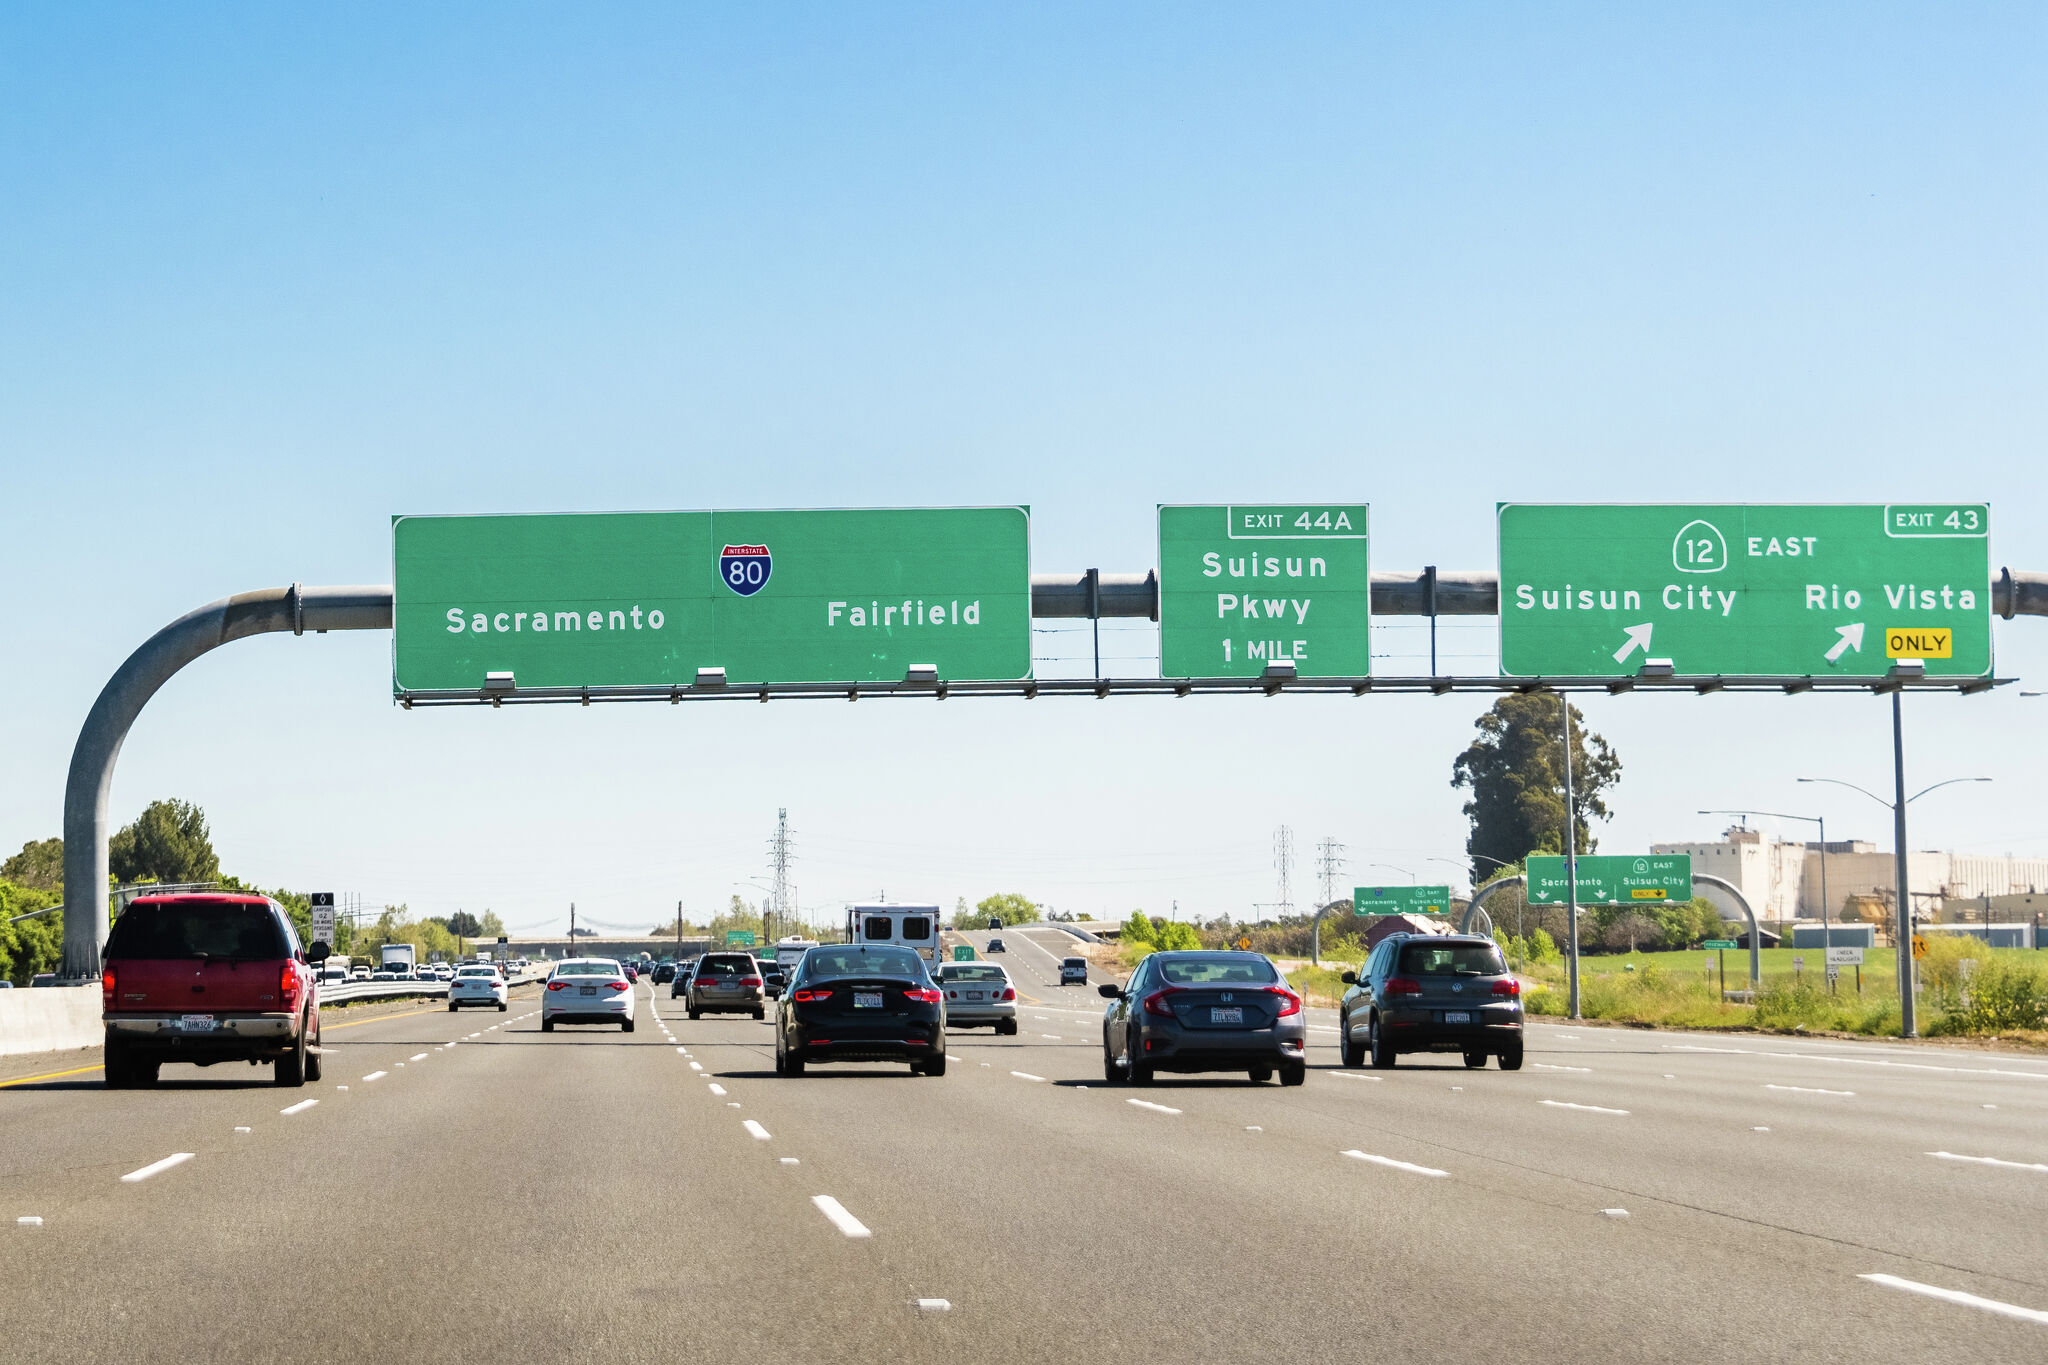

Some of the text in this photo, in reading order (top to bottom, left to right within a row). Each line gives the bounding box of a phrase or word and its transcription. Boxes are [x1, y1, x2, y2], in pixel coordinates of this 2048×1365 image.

[1244, 511, 1353, 531] EXIT 44A
[1896, 510, 1979, 530] EXIT 43
[1686, 539, 1713, 563] 12
[1747, 536, 1817, 557] EAST
[729, 560, 763, 585] 80
[1202, 551, 1326, 578] Suisun
[1217, 593, 1311, 625] Pkwy
[1515, 583, 1737, 617] Suisun City
[1805, 584, 1976, 610] Rio Vista
[447, 604, 665, 634] Sacramento
[828, 599, 980, 627] Fairfield
[1222, 638, 1308, 662] 1 MILE
[1890, 635, 1946, 651] ONLY
[1636, 863, 1645, 871] 12
[1623, 876, 1684, 887] Suisun City
